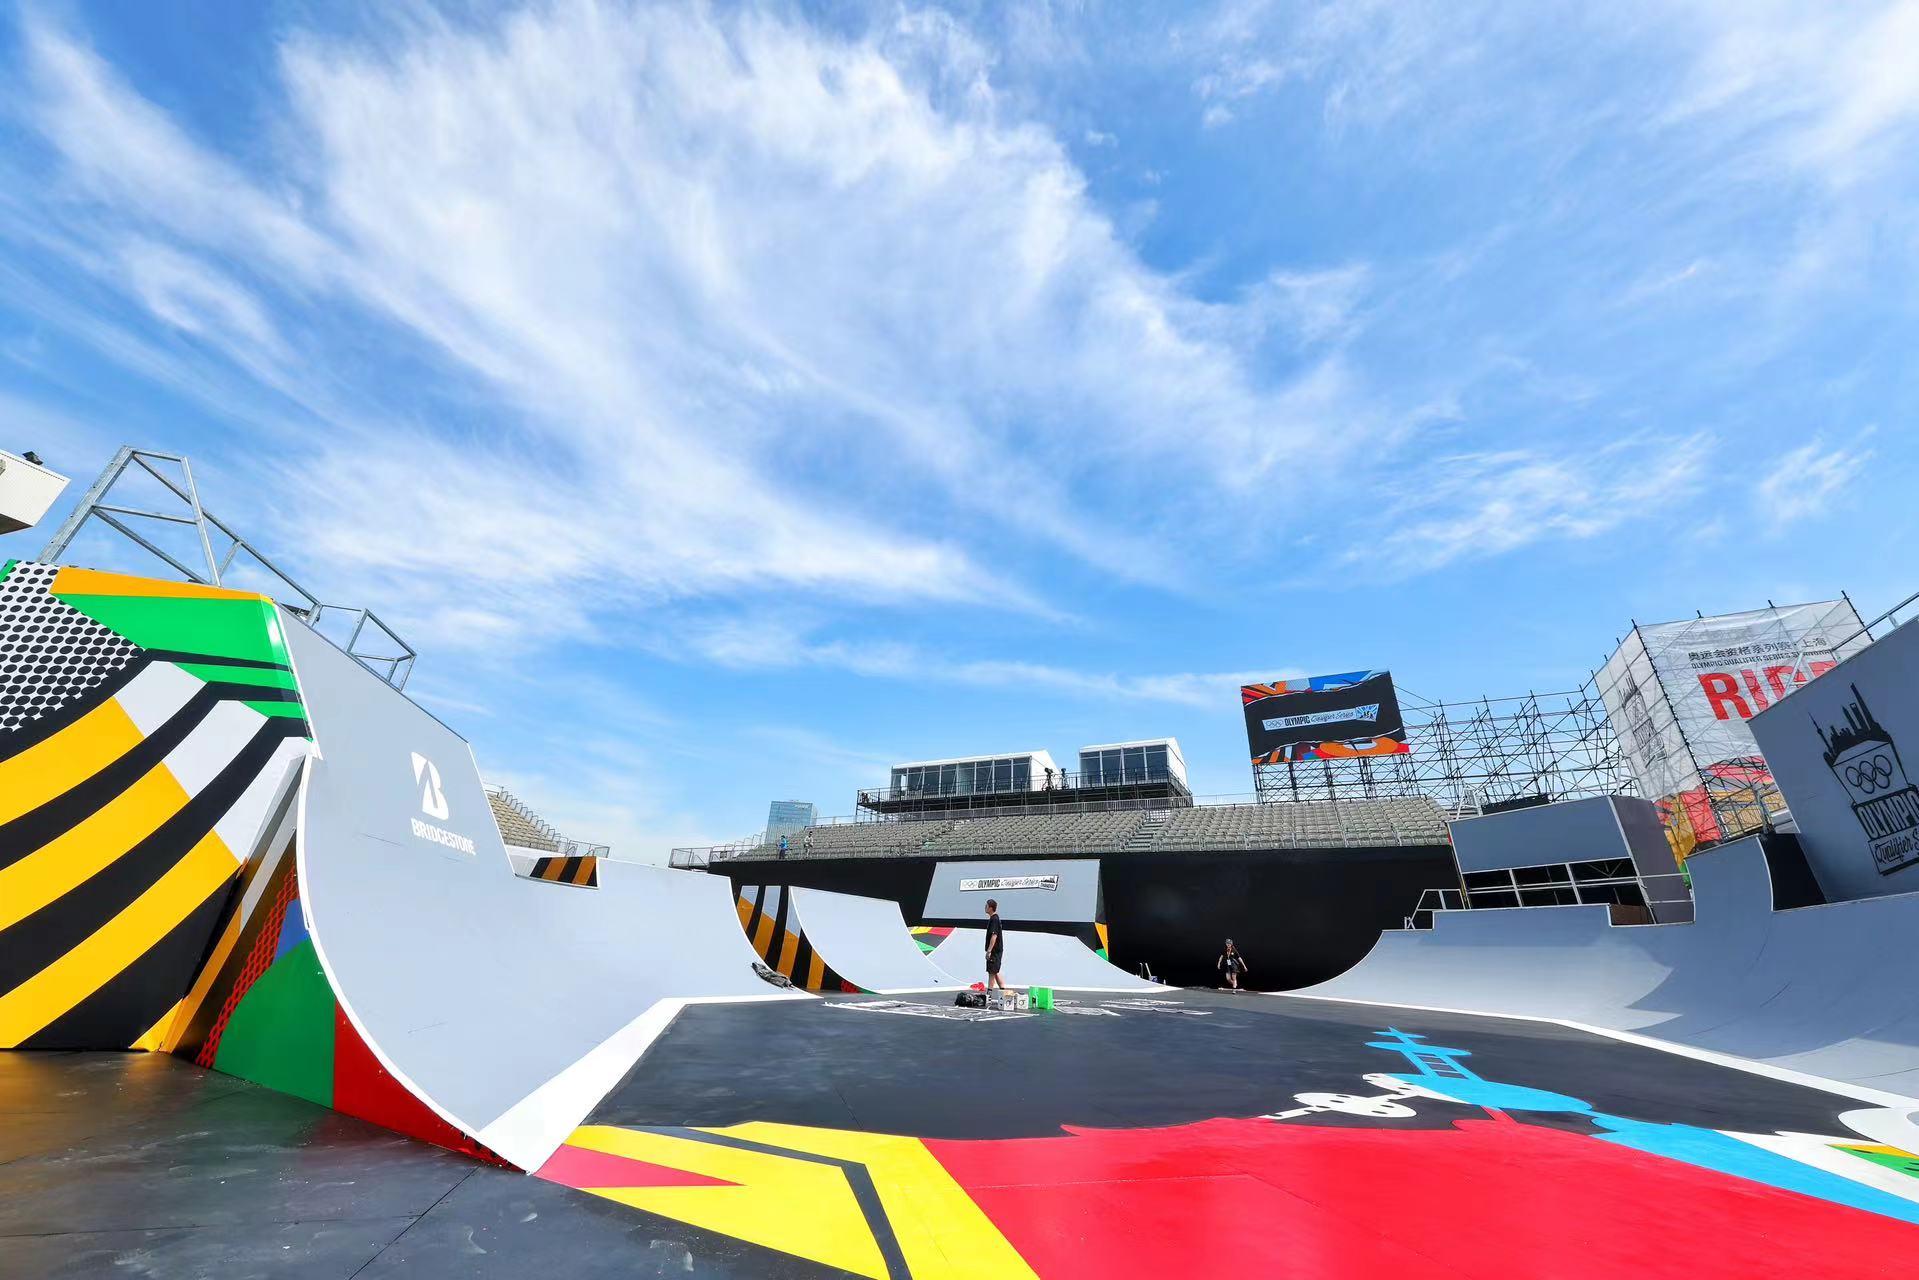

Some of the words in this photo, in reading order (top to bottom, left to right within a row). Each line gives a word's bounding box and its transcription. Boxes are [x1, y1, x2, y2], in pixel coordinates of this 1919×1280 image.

[1691, 660, 1723, 669] OLYMPIC
[1724, 655, 1763, 666] QUALIFIER
[1763, 652, 1791, 661] SERIES
[1284, 715, 1311, 727] OLYMPIC
[977, 879, 1001, 889] OLYMPIC
